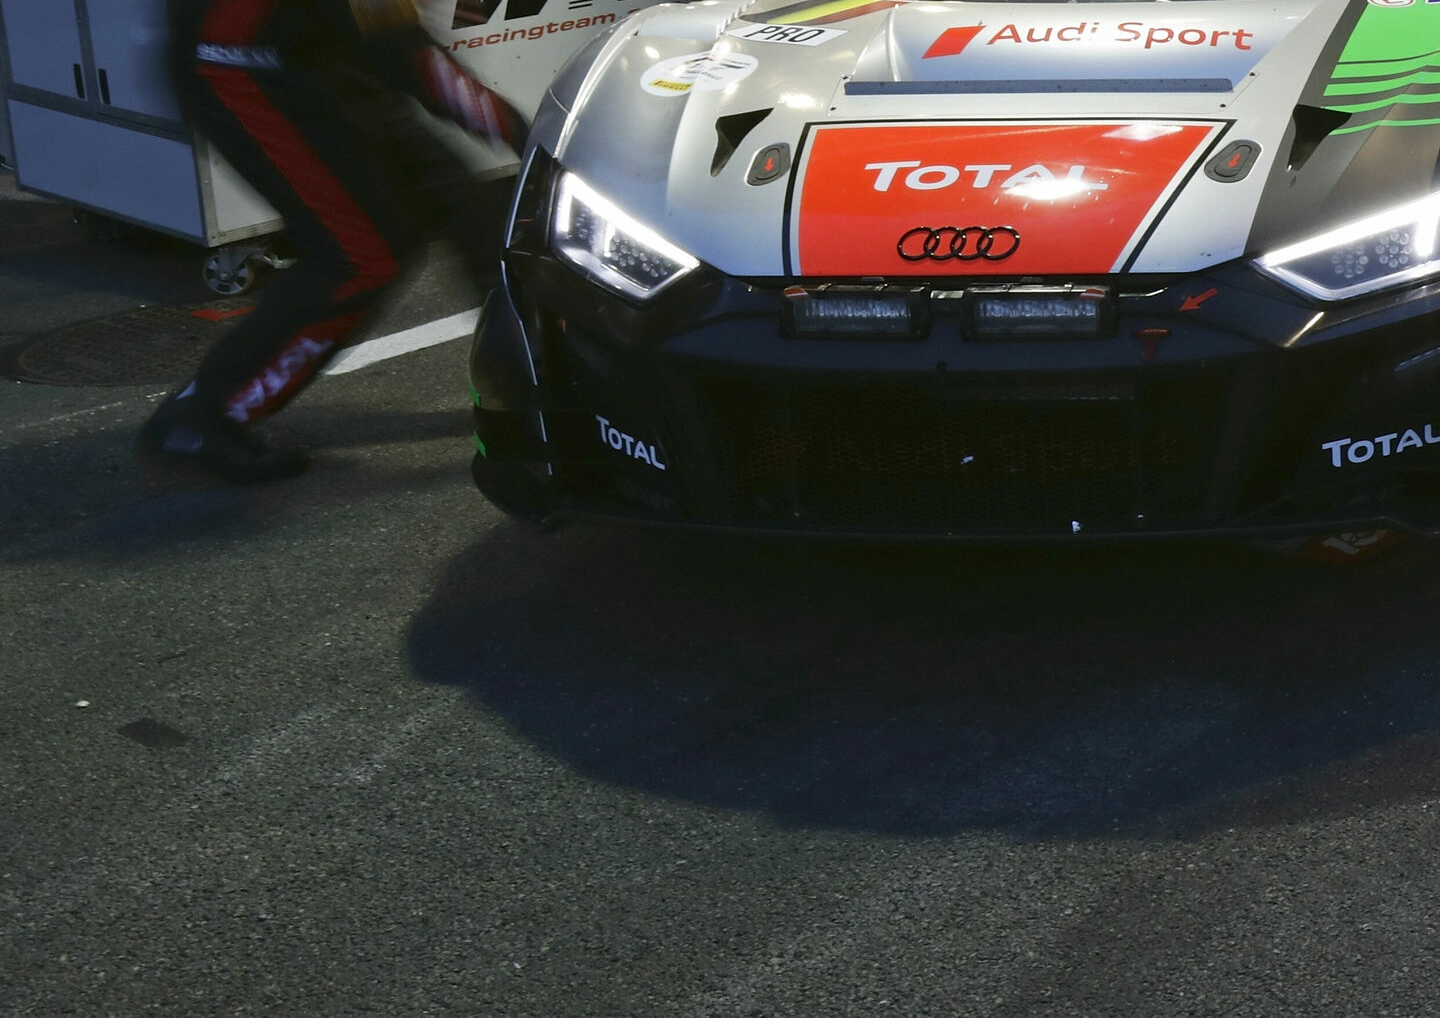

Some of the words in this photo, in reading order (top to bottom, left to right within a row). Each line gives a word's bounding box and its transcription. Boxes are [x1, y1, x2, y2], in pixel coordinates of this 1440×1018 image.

[744, 26, 825, 43] PRO
[986, 22, 1099, 45] Audi
[1114, 22, 1253, 50] Sport
[864, 160, 1108, 192] TOTAL
[595, 413, 666, 471] TOTAL
